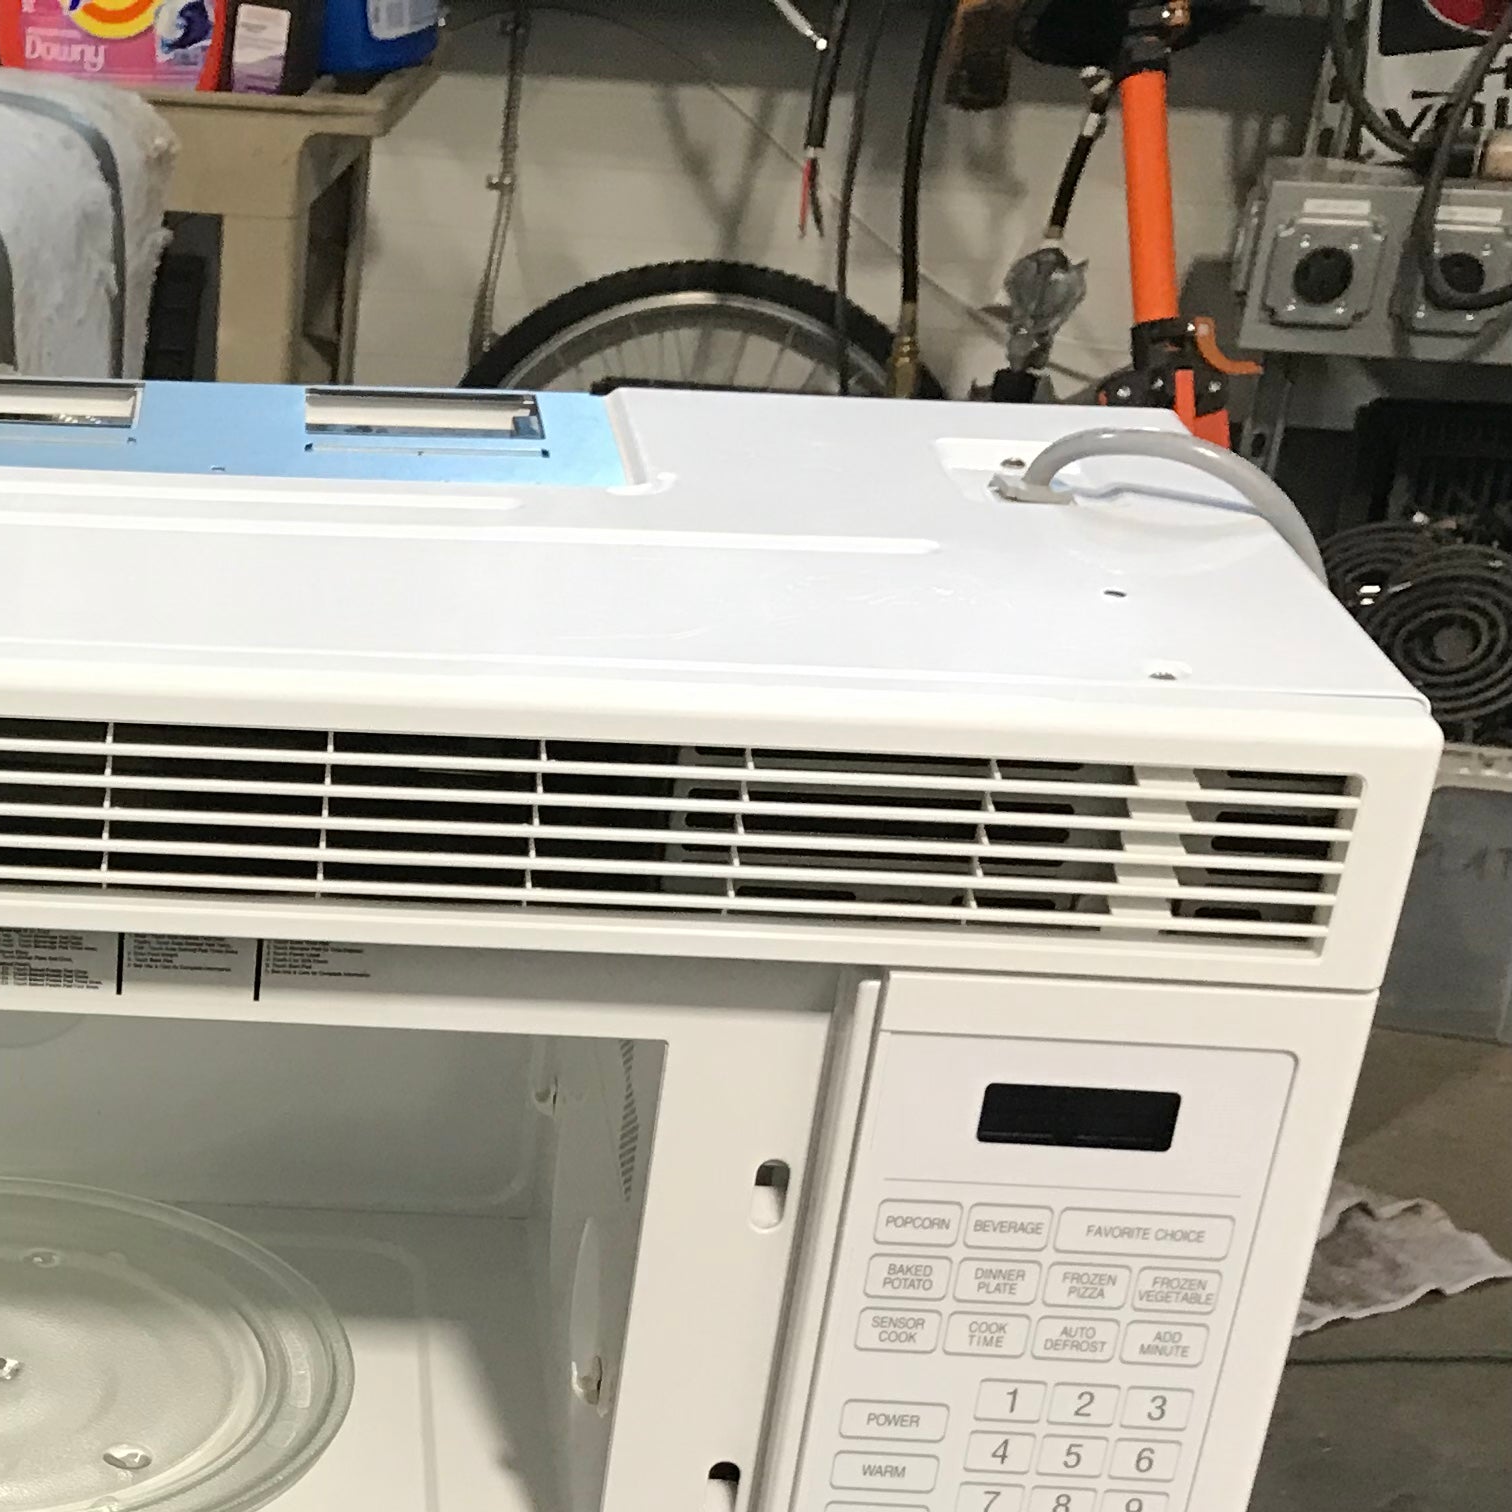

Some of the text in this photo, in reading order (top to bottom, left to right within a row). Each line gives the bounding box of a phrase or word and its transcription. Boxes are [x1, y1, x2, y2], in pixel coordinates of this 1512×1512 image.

[25, 35, 105, 72] Downy
[885, 1215, 950, 1230] POPCORN
[974, 1219, 1044, 1236] BEVERAGE
[1086, 1224, 1205, 1243] FAVORITE CHOICE
[887, 1263, 933, 1278] BAKED
[974, 1268, 1026, 1282] DINNER
[883, 1277, 933, 1292] POTATO
[1062, 1272, 1117, 1287] FROZEN
[1152, 1276, 1208, 1292] FROZEN
[977, 1281, 1017, 1296] PLATE
[1068, 1285, 1105, 1299] PIZZA
[1138, 1290, 1213, 1305] VEGETABLE
[872, 1316, 925, 1331] SENSOR
[969, 1320, 1008, 1335] COOK
[878, 1329, 918, 1344] COOK
[1060, 1325, 1096, 1339] AUTO
[1152, 1330, 1182, 1344] ADD
[967, 1334, 1004, 1349] TIME
[1044, 1337, 1106, 1353] DEFROST
[1139, 1342, 1190, 1358] MINUTE
[1006, 1387, 1019, 1413] 1
[1074, 1391, 1095, 1417] 2
[1147, 1395, 1168, 1421] 3
[867, 1413, 920, 1428] POWER
[992, 1438, 1009, 1465] 4
[1063, 1443, 1083, 1469] 5
[1135, 1447, 1155, 1473] 6
[862, 1464, 906, 1479] WARM
